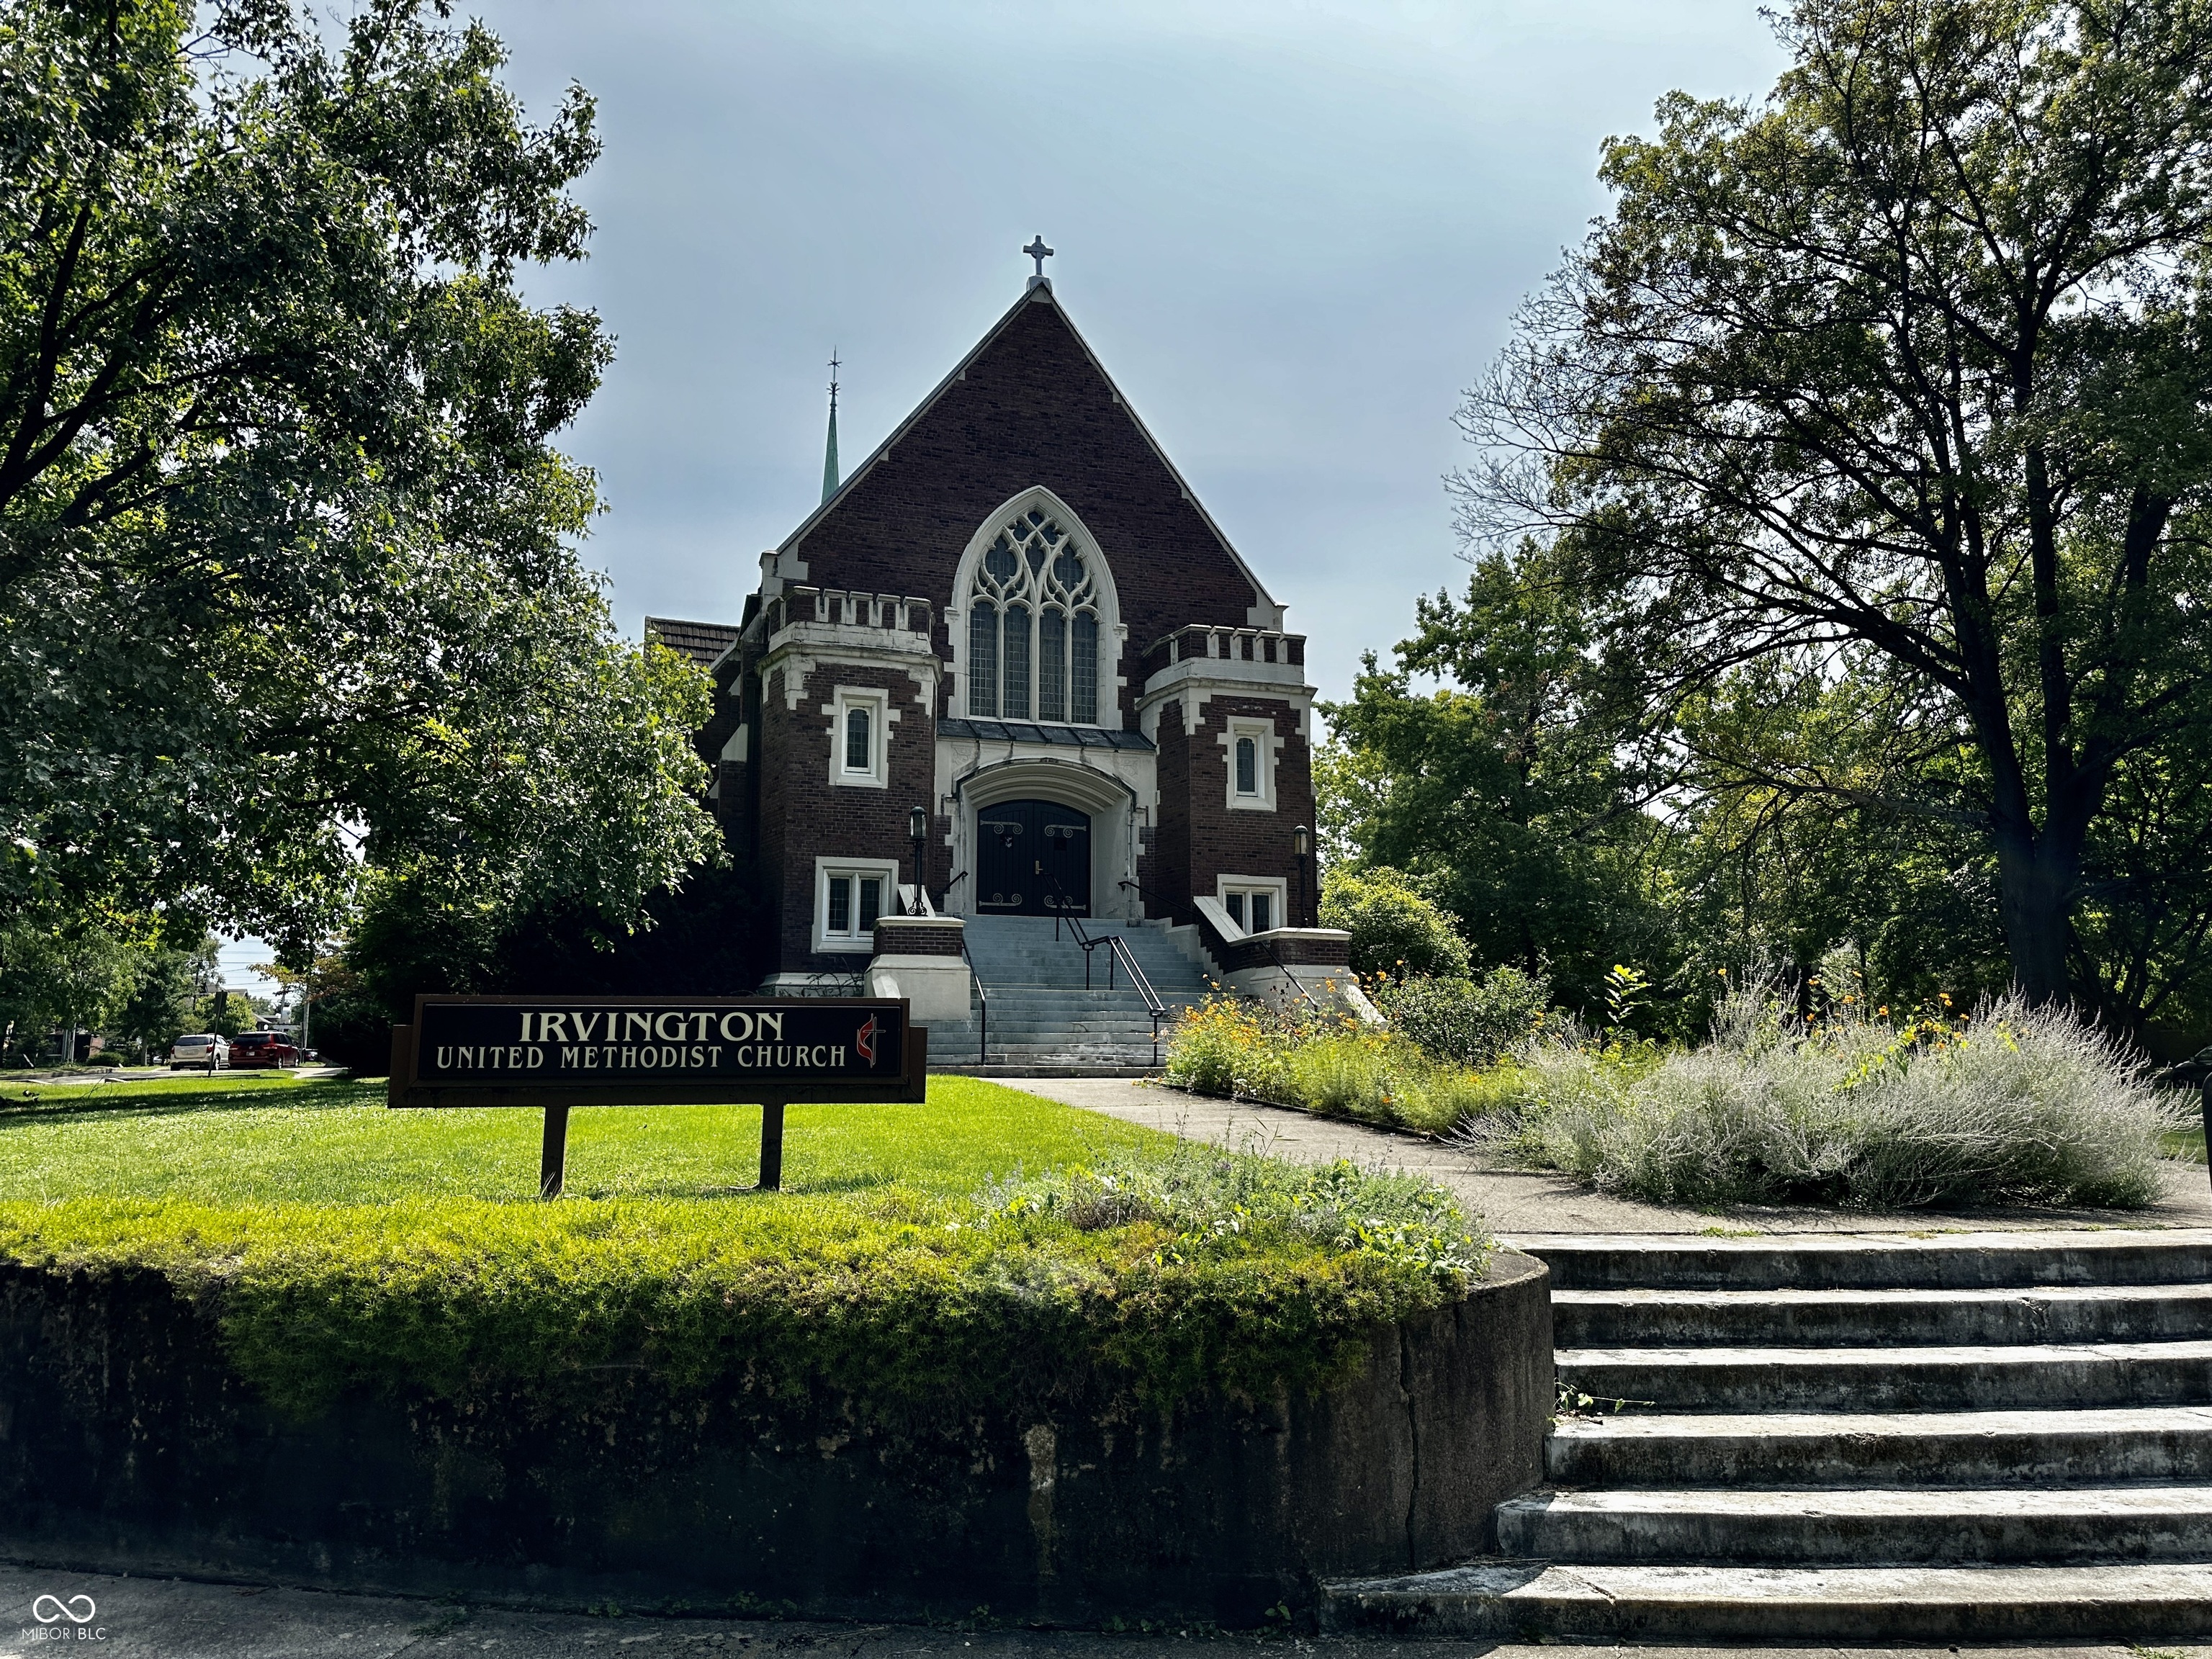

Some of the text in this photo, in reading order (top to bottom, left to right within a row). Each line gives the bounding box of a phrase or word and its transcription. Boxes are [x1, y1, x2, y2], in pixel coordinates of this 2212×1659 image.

[518, 1012, 785, 1042] IRVINGTON
[437, 1045, 846, 1069] UNITED METHODIST CHURCH
